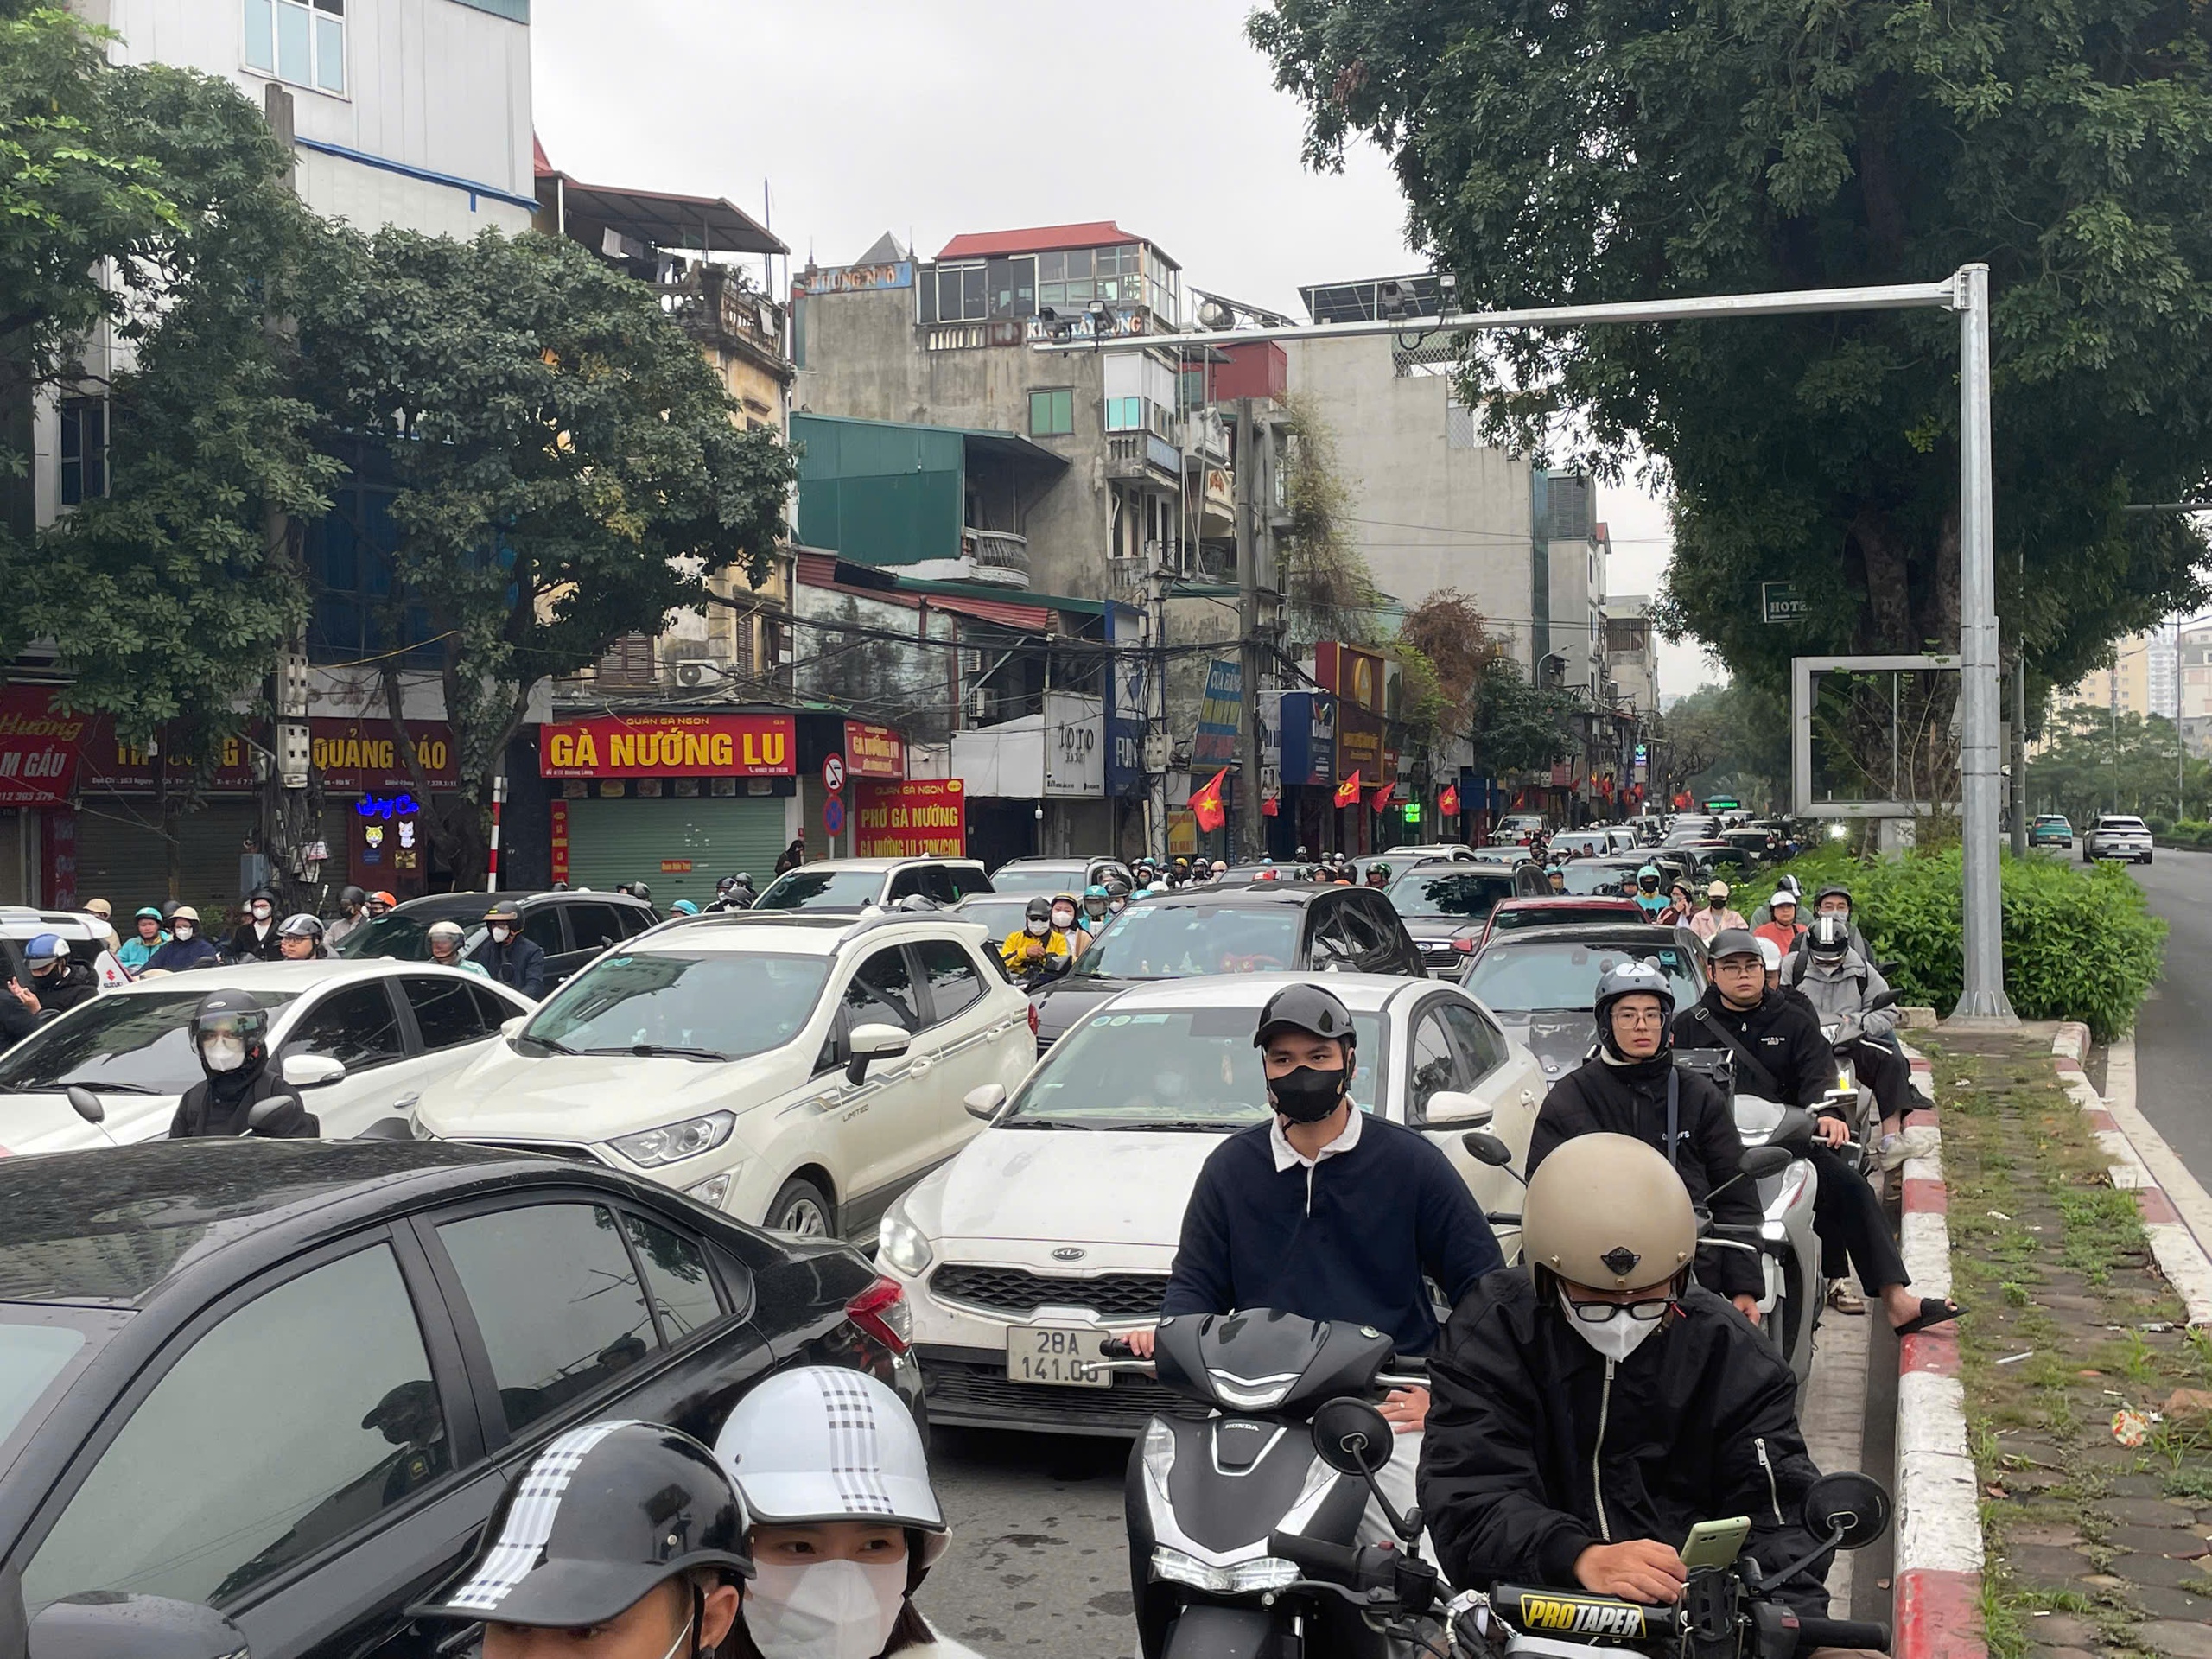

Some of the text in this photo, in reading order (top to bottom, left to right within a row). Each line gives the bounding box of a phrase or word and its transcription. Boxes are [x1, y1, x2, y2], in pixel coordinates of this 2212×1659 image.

[1770, 600, 1813, 613] HOTE
[626, 715, 710, 726] QUÁN GÀ NGON
[312, 728, 394, 771] QUẢNG
[550, 727, 785, 767] GÀ NƯỚNG LU
[918, 785, 944, 795] NGON
[861, 802, 959, 829] PHỞ GÀ NƯỚNG
[842, 1103, 869, 1122] LIMITED
[1037, 1331, 1079, 1356] 28A
[1224, 1422, 1260, 1432] HONDA
